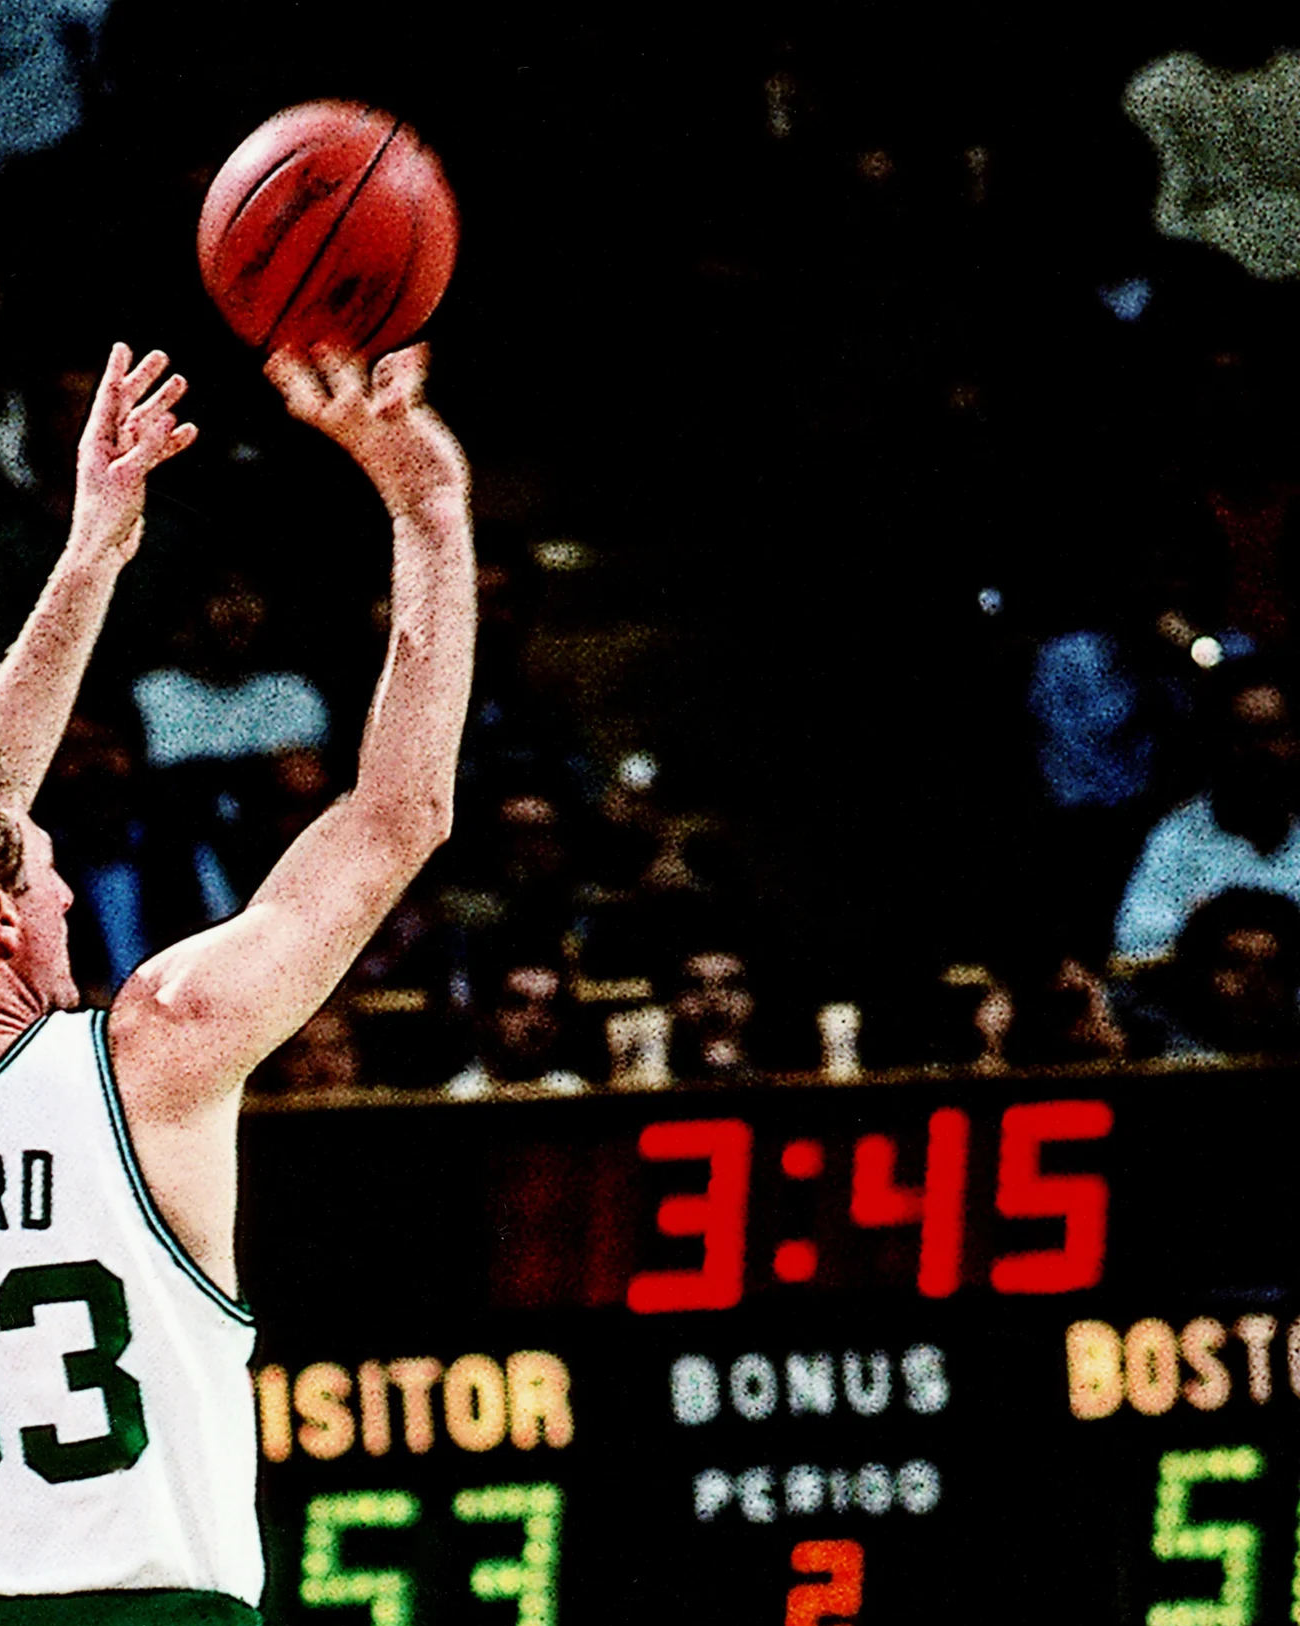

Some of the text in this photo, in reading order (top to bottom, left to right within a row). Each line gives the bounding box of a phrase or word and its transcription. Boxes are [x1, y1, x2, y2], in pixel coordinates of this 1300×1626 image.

[627, 1101, 1113, 1315] 3:45
[256, 1349, 573, 1462] ISITOR
[670, 1342, 950, 1426] BONUS
[1065, 1312, 1300, 1421] BOST
